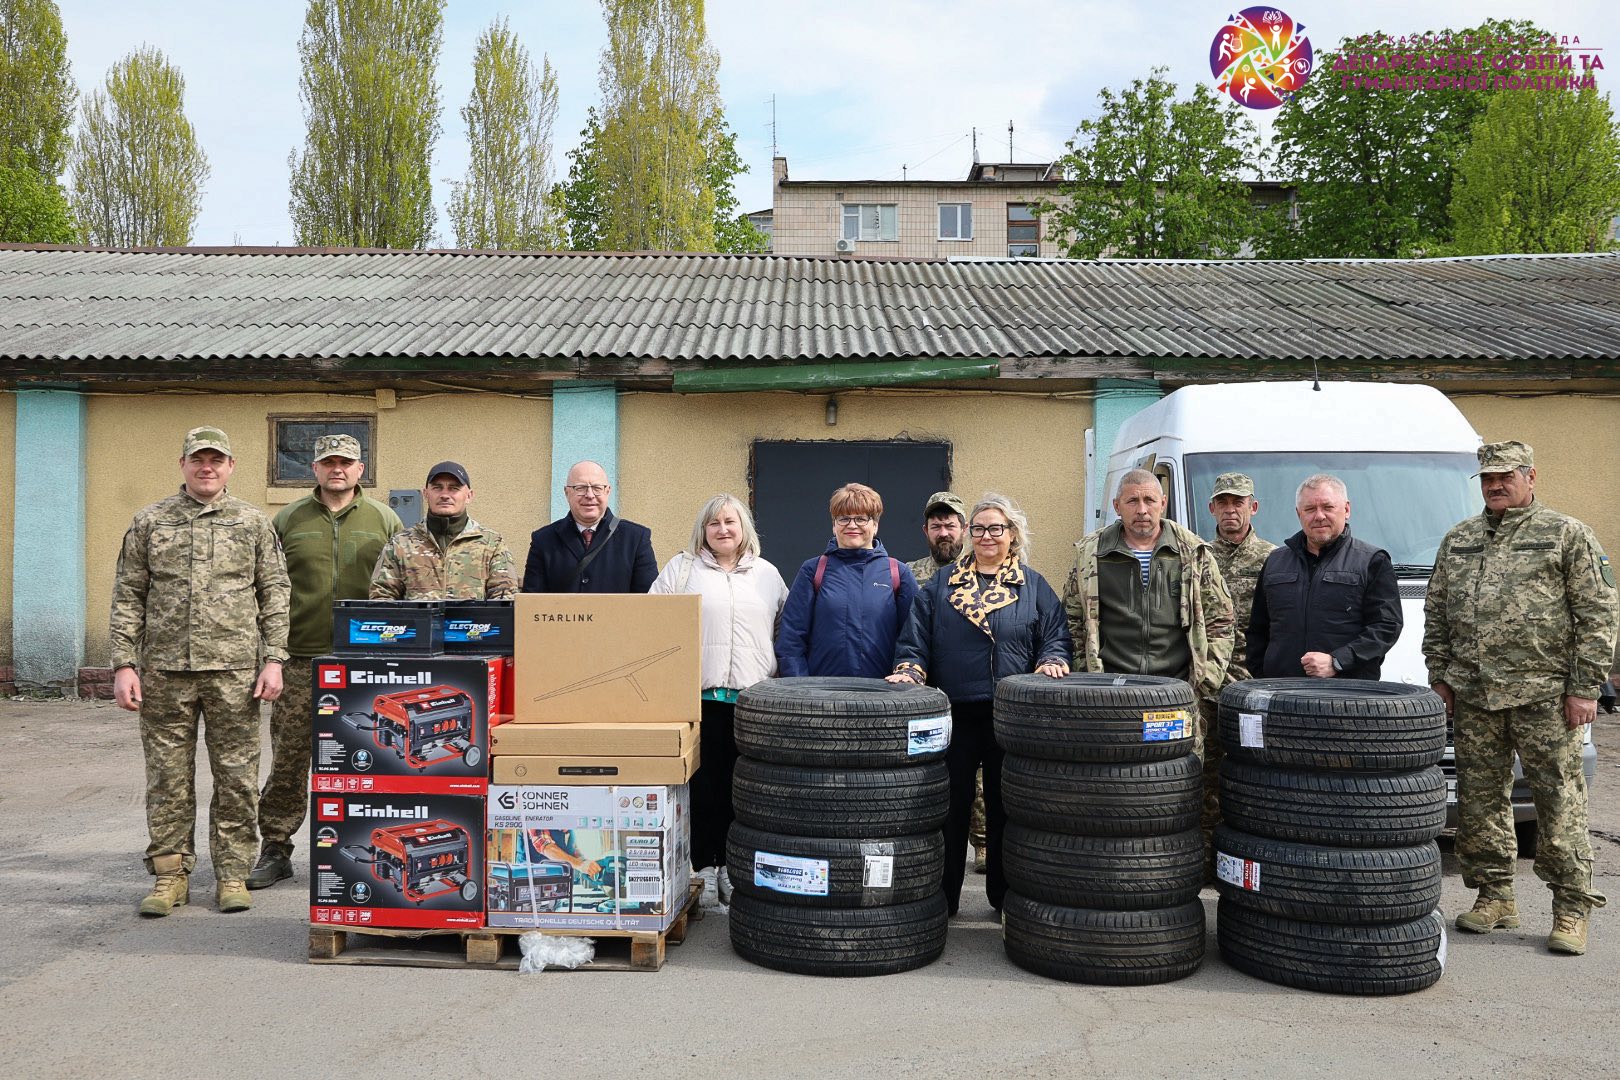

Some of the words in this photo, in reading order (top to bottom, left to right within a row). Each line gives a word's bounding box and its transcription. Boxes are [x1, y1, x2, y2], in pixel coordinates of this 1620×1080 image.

[533, 614, 594, 622] STARLINK
[360, 624, 407, 632] ELECTRON
[448, 623, 491, 631] ELECTRON
[350, 670, 432, 684] Einhell
[348, 803, 429, 819] Einhell
[567, 918, 605, 926] DEUTSCHE
